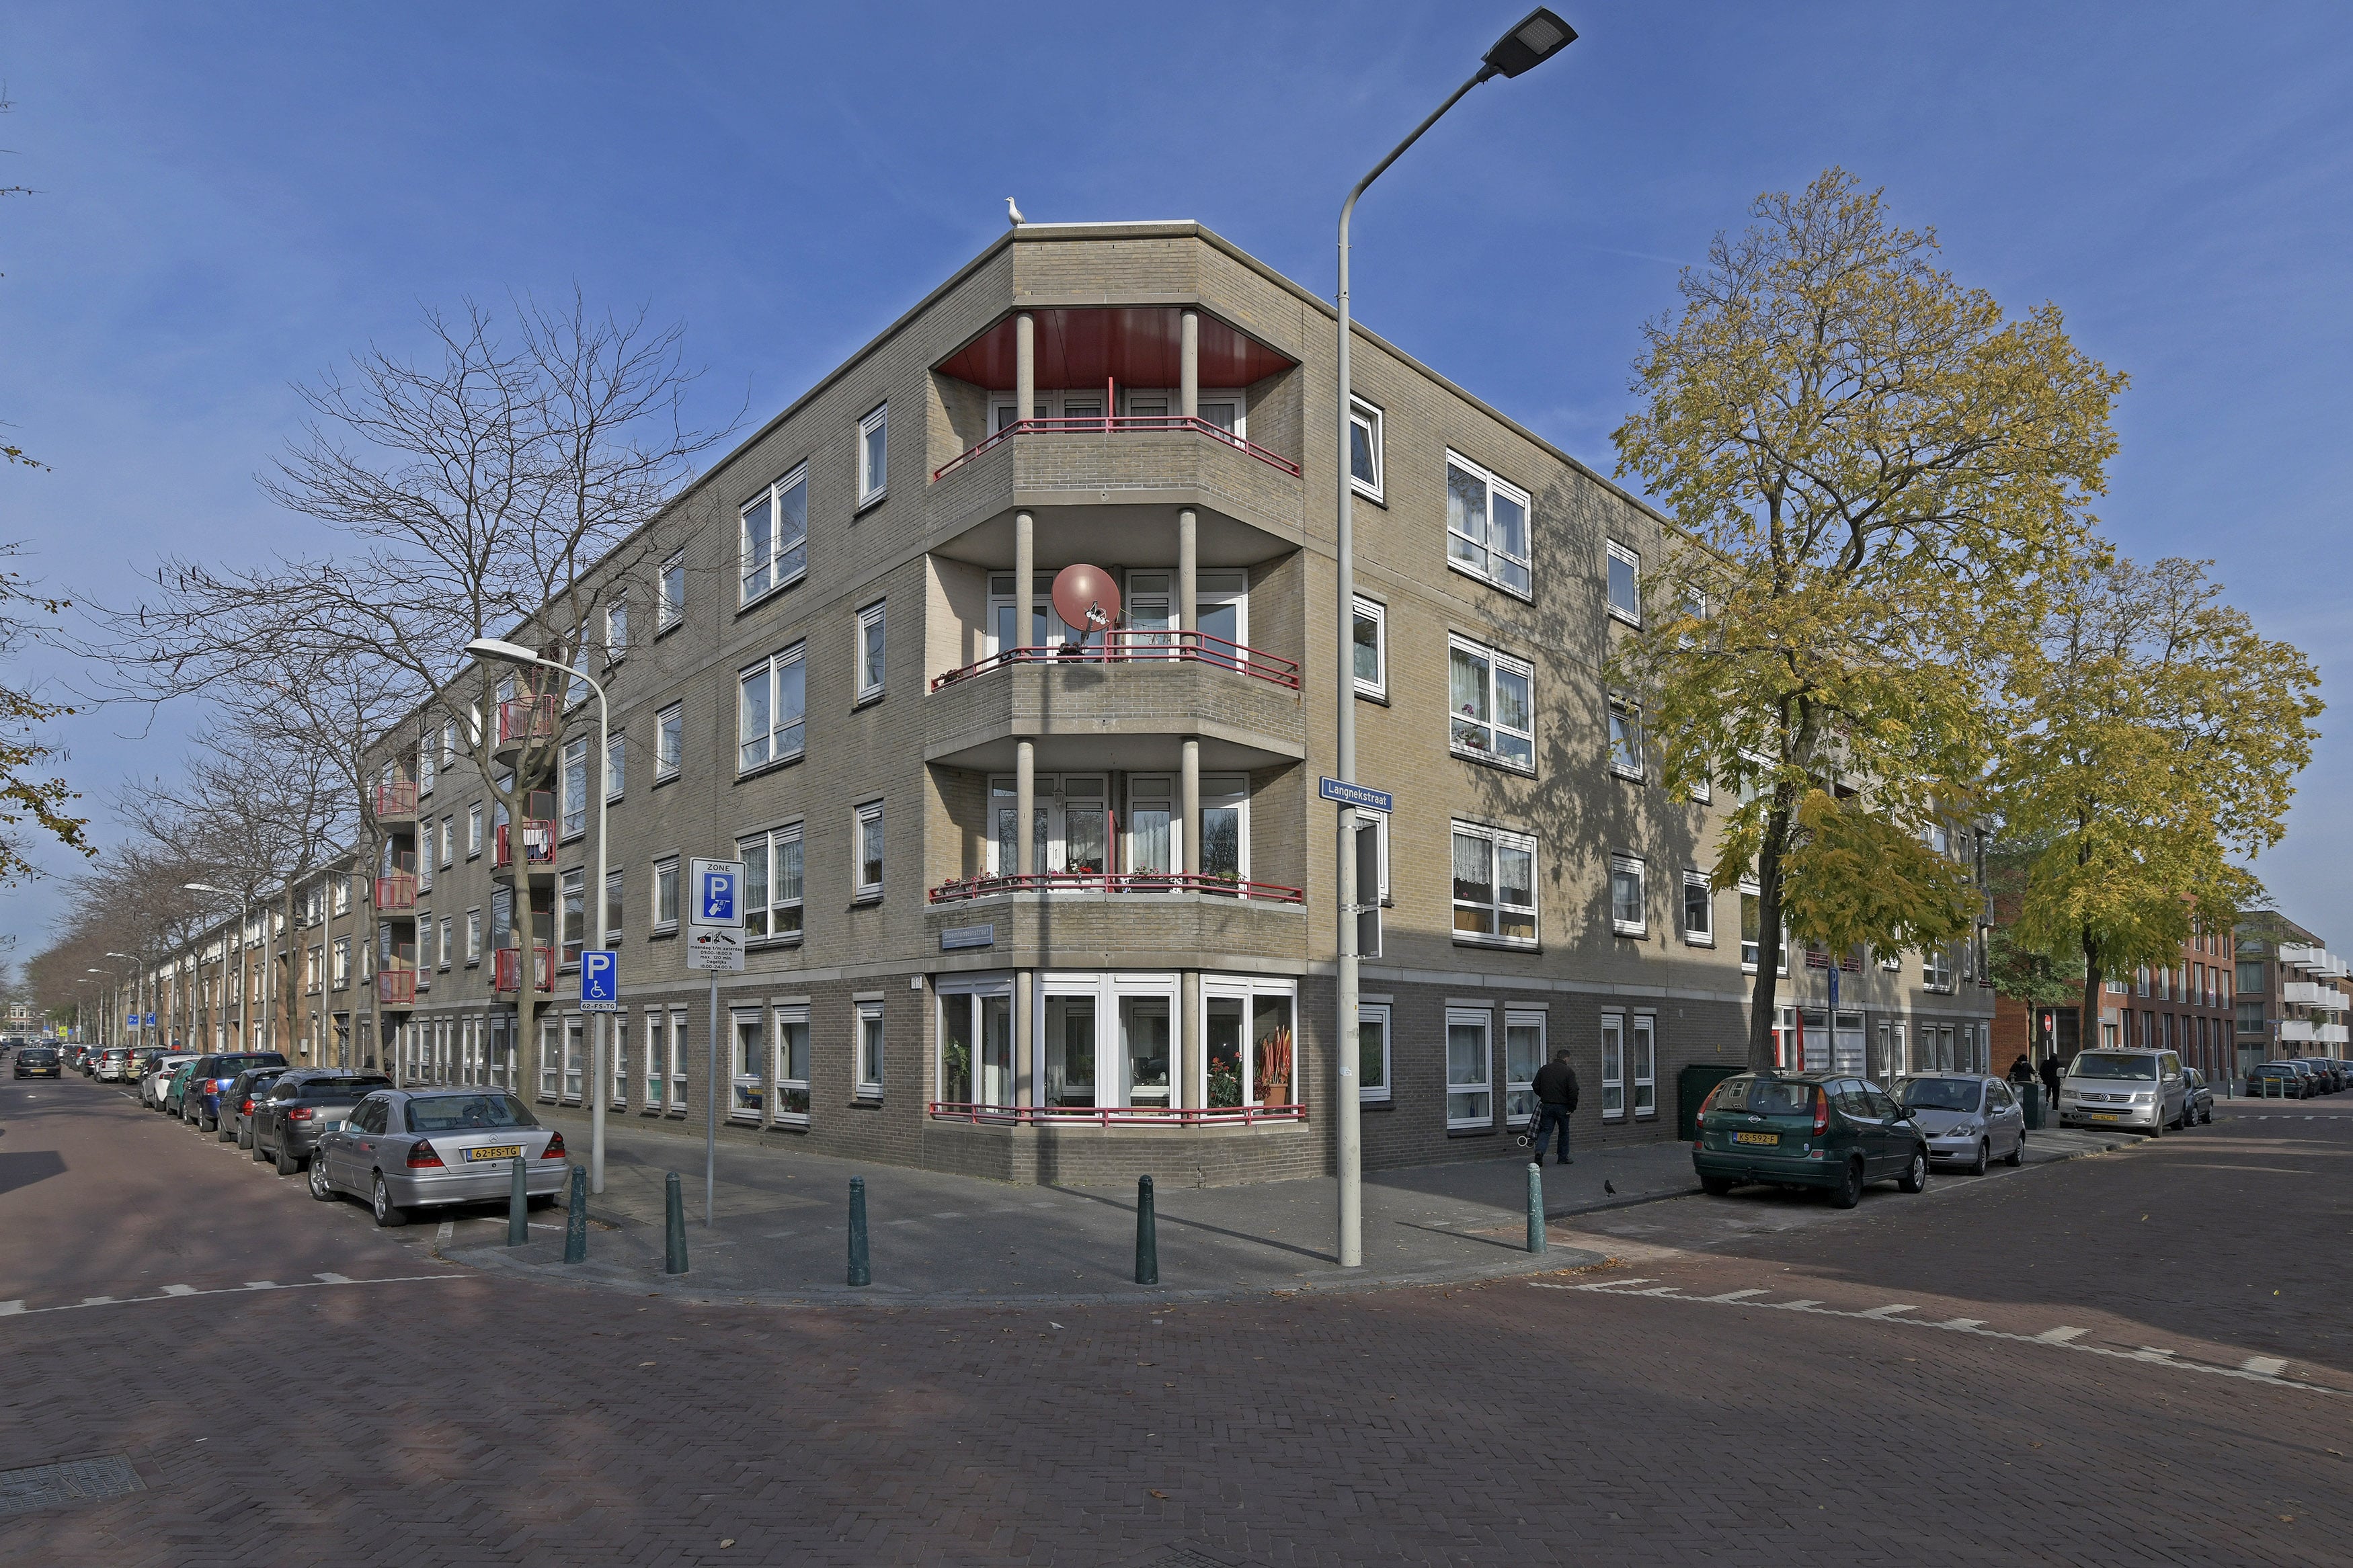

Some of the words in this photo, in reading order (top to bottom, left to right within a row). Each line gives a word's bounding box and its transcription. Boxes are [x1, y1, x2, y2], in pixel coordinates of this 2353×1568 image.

[1328, 782, 1387, 806] Langnekstraat
[707, 864, 730, 872] ZONE
[711, 876, 728, 899] P
[944, 928, 989, 940] Bloemfonteinstraat
[588, 954, 610, 979] P
[1832, 970, 1837, 988] P
[1739, 1134, 1775, 1143] KS-592-F
[475, 1147, 516, 1158] 62-FS-TG
